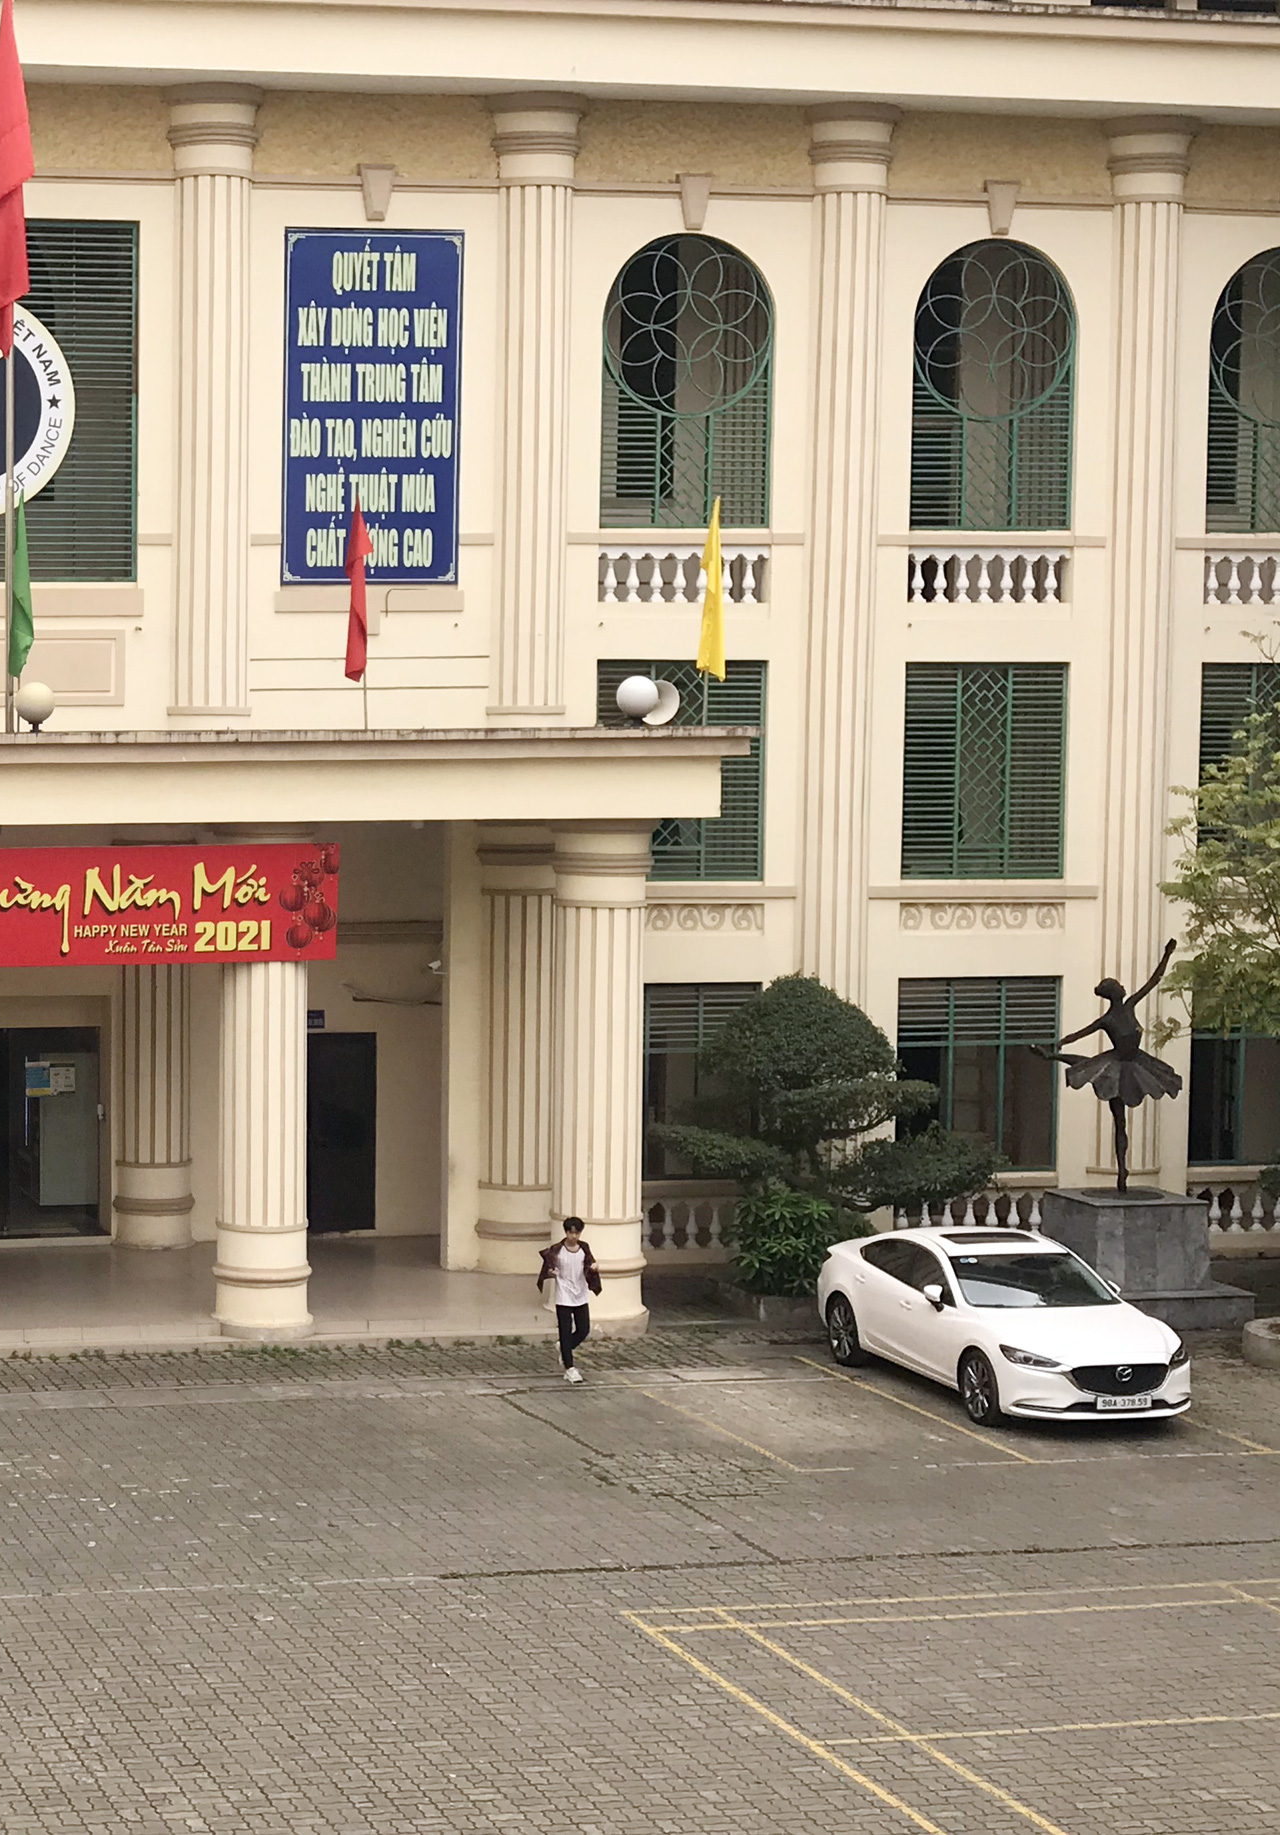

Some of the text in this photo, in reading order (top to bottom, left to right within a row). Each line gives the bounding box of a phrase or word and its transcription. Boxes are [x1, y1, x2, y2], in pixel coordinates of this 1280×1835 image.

[332, 239, 417, 295] QUYẾT TÂM
[297, 300, 448, 355] XÂY DỰNG HỌC VIỆN
[32, 343, 61, 387] NAM
[301, 357, 443, 403] THÀNH TRUNG TÂM
[27, 417, 63, 476] DANCE
[290, 412, 453, 465] ĐÀO TẠO, NGHIÊN CỨU
[305, 467, 436, 520] NGHỆ THUẬT MÚA
[306, 516, 433, 574] CHẤT ỢNG CAO
[83, 863, 181, 920] Năm
[193, 862, 271, 911] Mới
[74, 924, 188, 938] HAPPY NEW YEAR
[105, 940, 137, 953] Xuân
[194, 920, 271, 953] 2021
